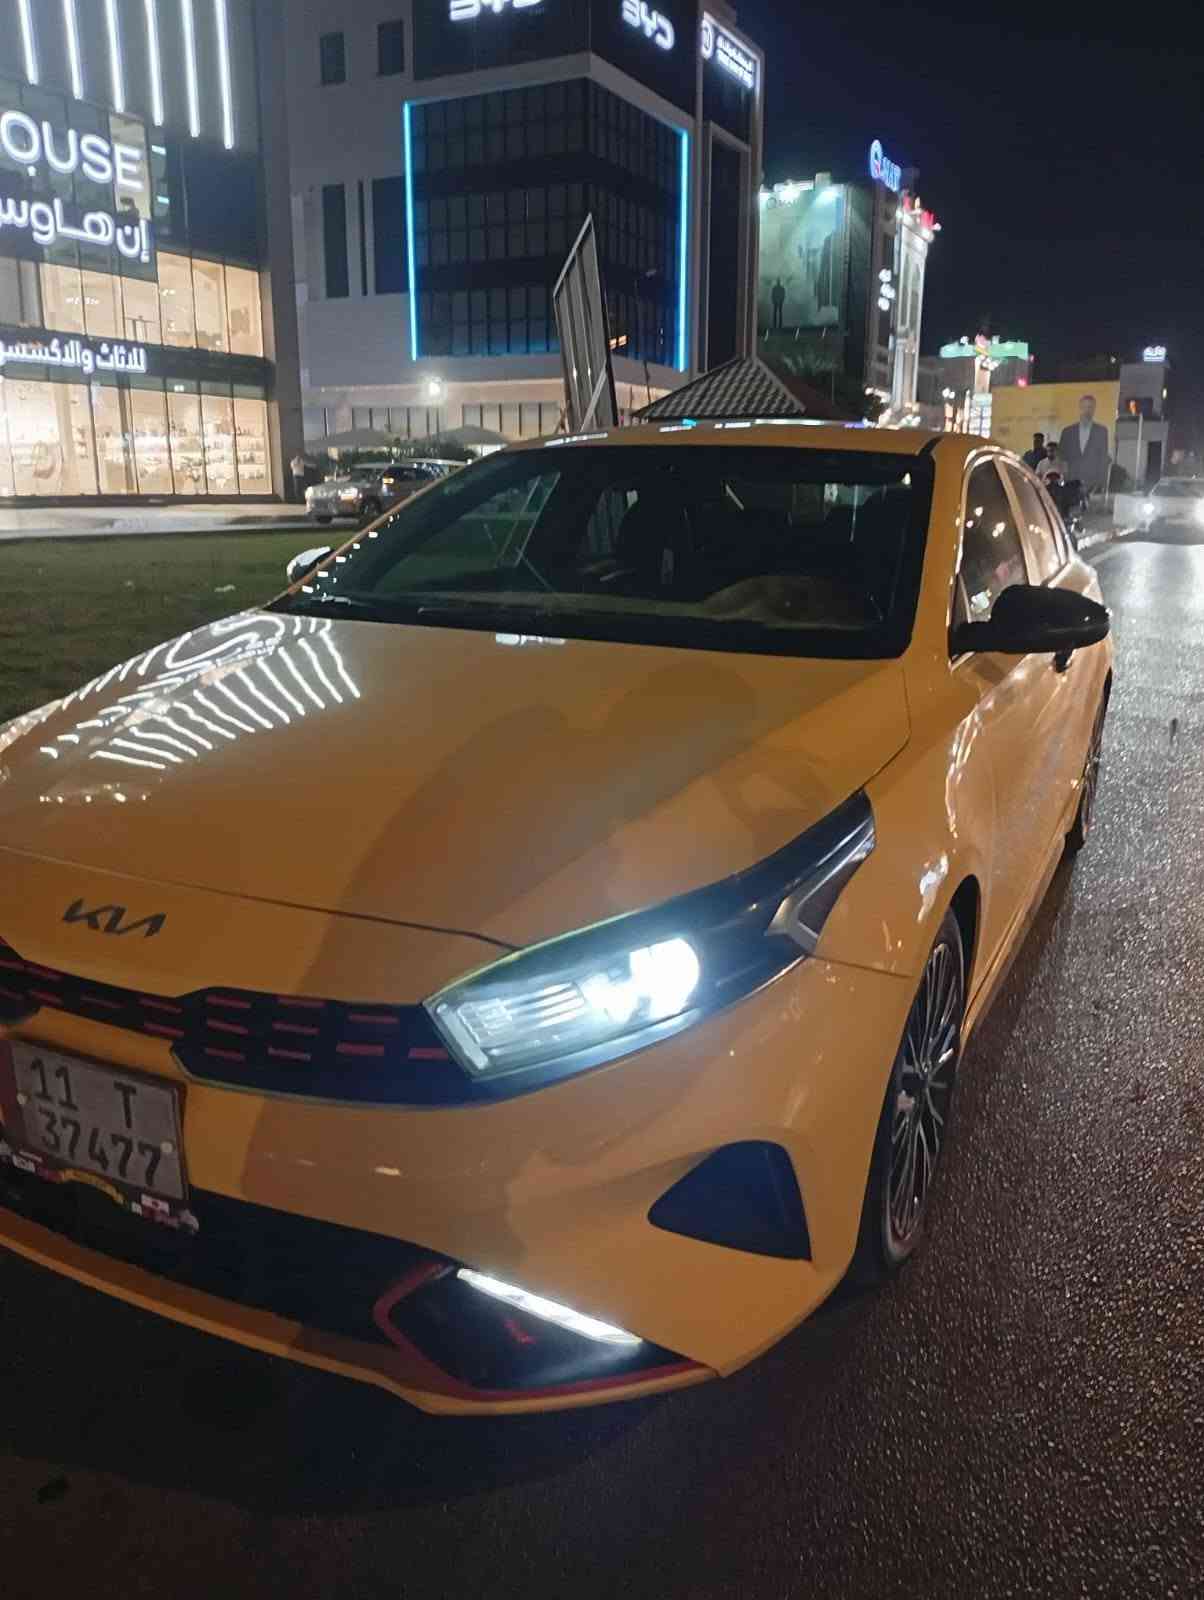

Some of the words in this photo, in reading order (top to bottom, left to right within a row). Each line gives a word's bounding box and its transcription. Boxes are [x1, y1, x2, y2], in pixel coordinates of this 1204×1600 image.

[622, 0, 675, 49] BYD
[30, 1057, 79, 1112] 11
[113, 1080, 138, 1129] T
[37, 1104, 162, 1189] 37477
